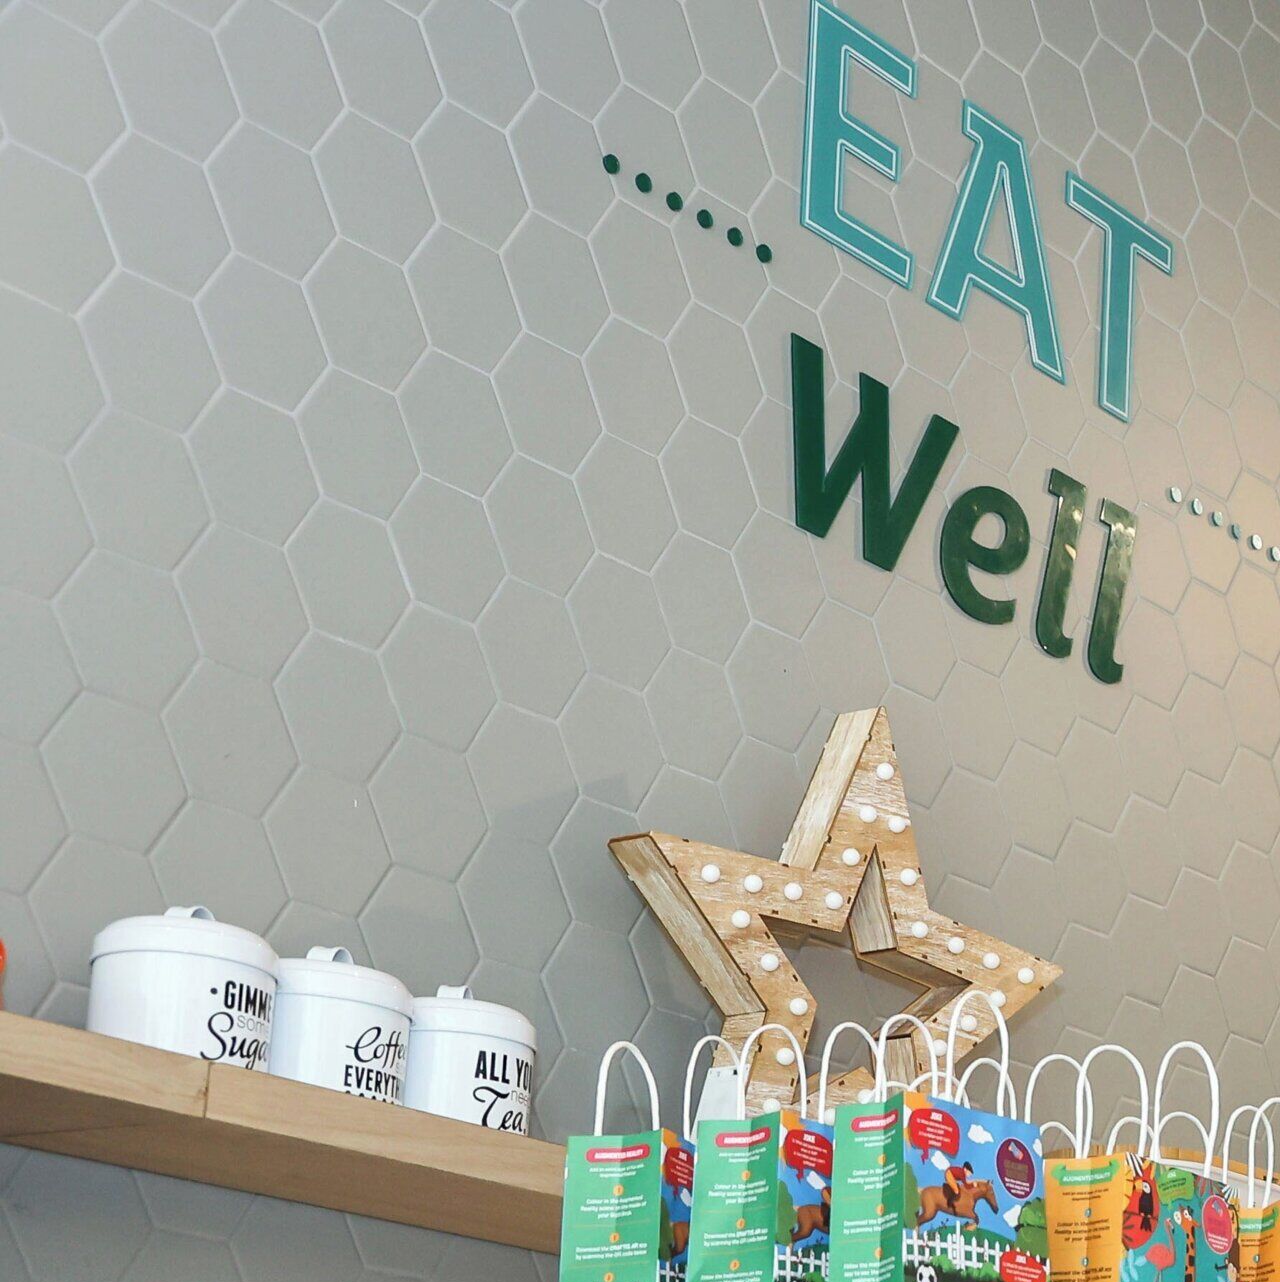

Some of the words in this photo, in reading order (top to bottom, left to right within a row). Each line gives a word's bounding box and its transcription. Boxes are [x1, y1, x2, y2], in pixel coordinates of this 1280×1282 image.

[801, 0, 1173, 424] EAT
[790, 332, 1138, 685] Well
[200, 1012, 269, 1070] Suga
[474, 1050, 510, 1085] ALL
